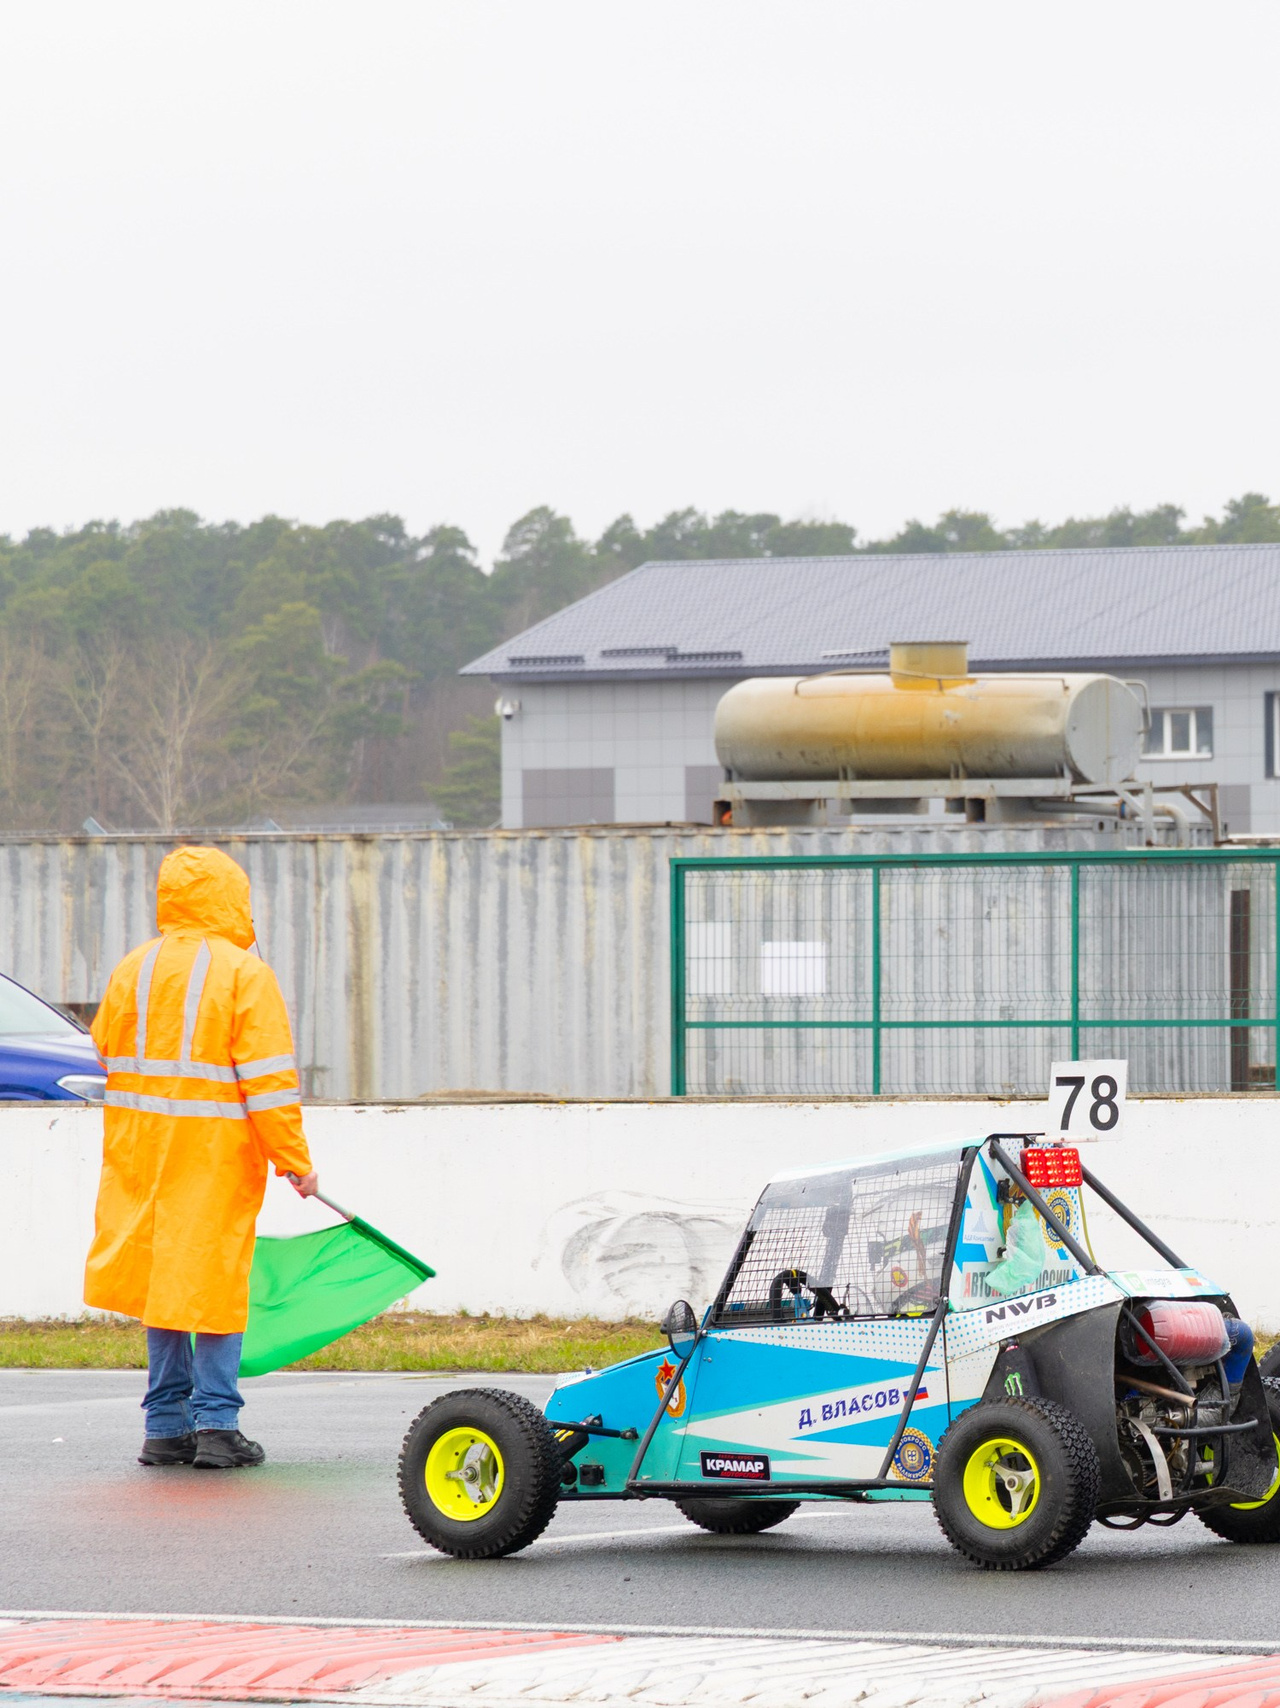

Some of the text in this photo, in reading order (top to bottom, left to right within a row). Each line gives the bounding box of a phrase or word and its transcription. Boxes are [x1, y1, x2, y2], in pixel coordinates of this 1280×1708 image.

[1055, 1074, 1119, 1131] 78
[985, 1293, 1057, 1324] NWB
[798, 1388, 900, 1430] Д. ВЛАСОВ
[706, 1458, 764, 1473] КРАМАР
